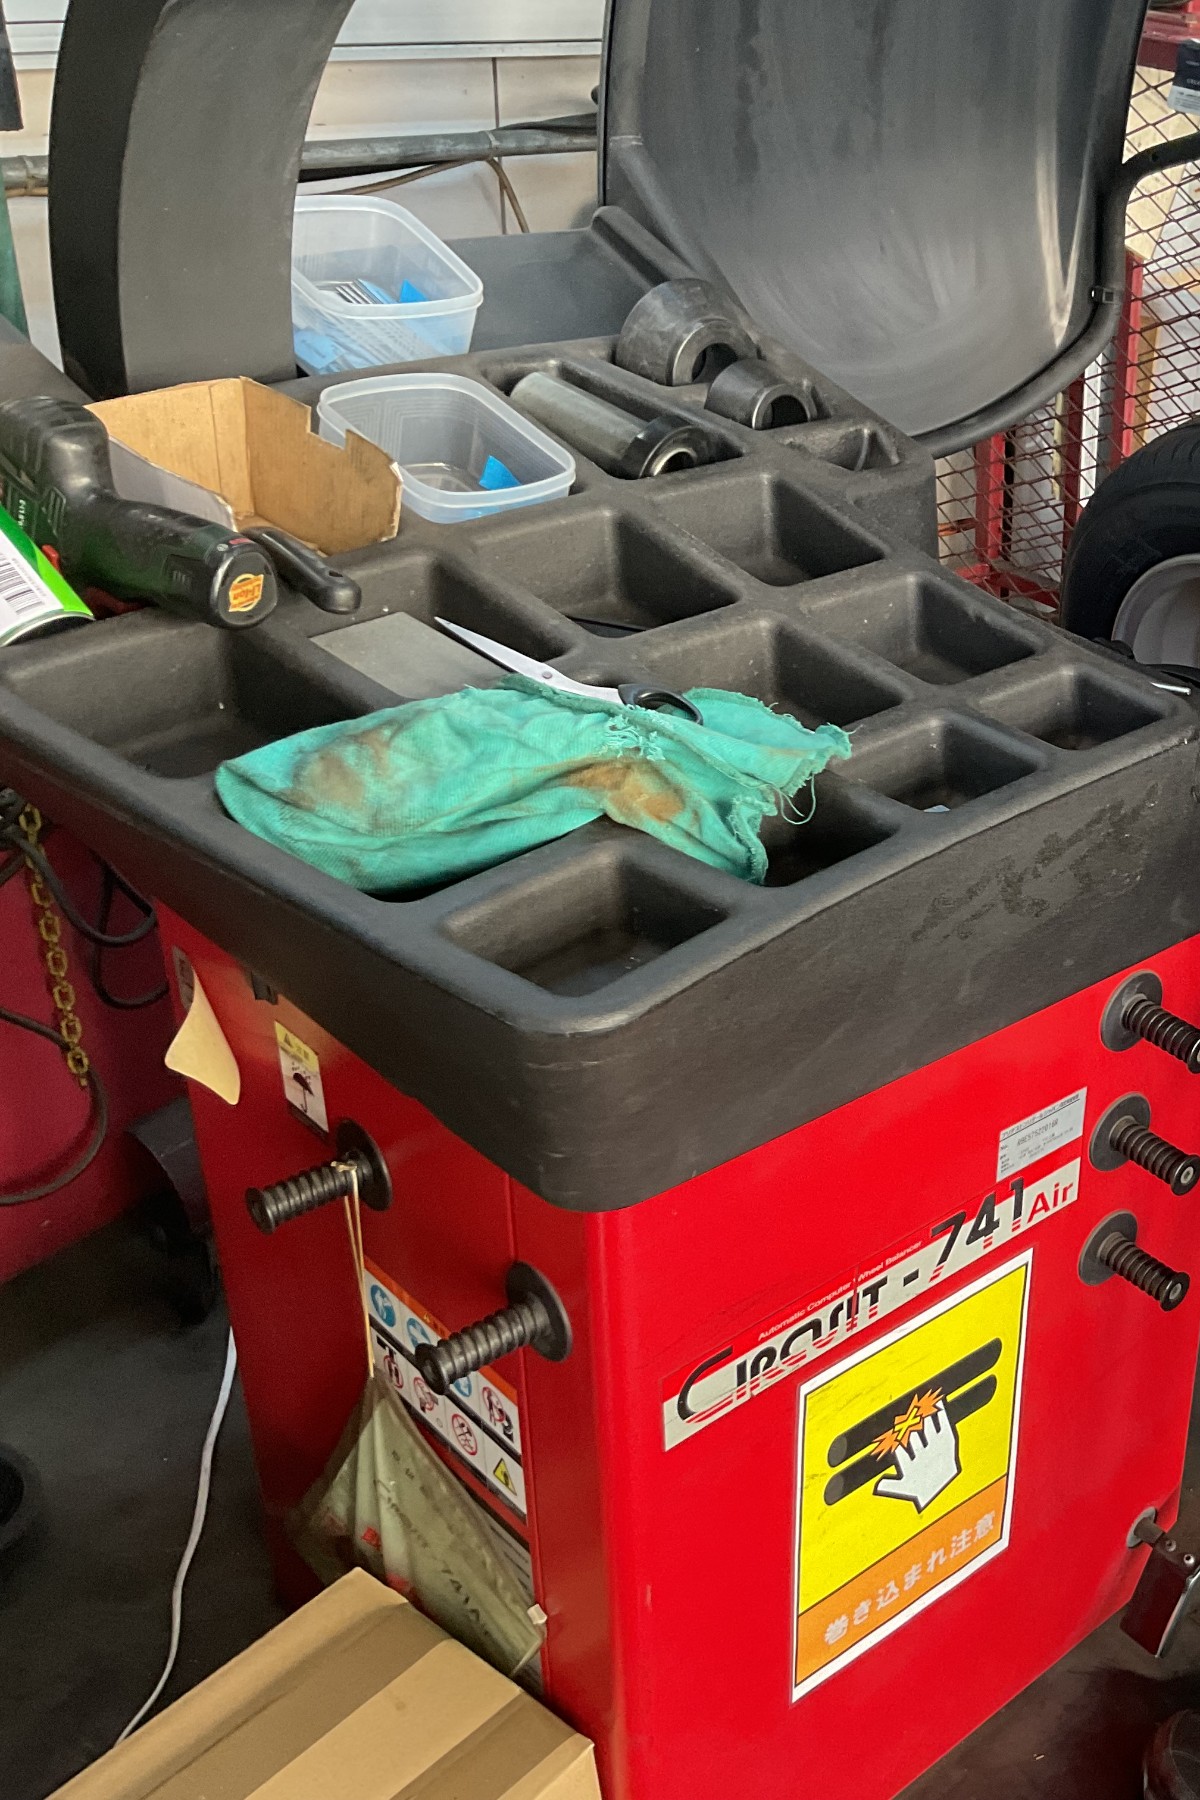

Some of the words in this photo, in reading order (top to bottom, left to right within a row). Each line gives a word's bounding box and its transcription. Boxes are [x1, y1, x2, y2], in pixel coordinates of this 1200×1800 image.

[1026, 1182, 1073, 1225] Air
[757, 1309, 806, 1341] Automatic
[807, 1282, 852, 1312] Computer
[852, 1262, 884, 1284] Wheel
[885, 1240, 923, 1267] Balancer
[824, 1510, 996, 1646] 巻き込まれ注意
